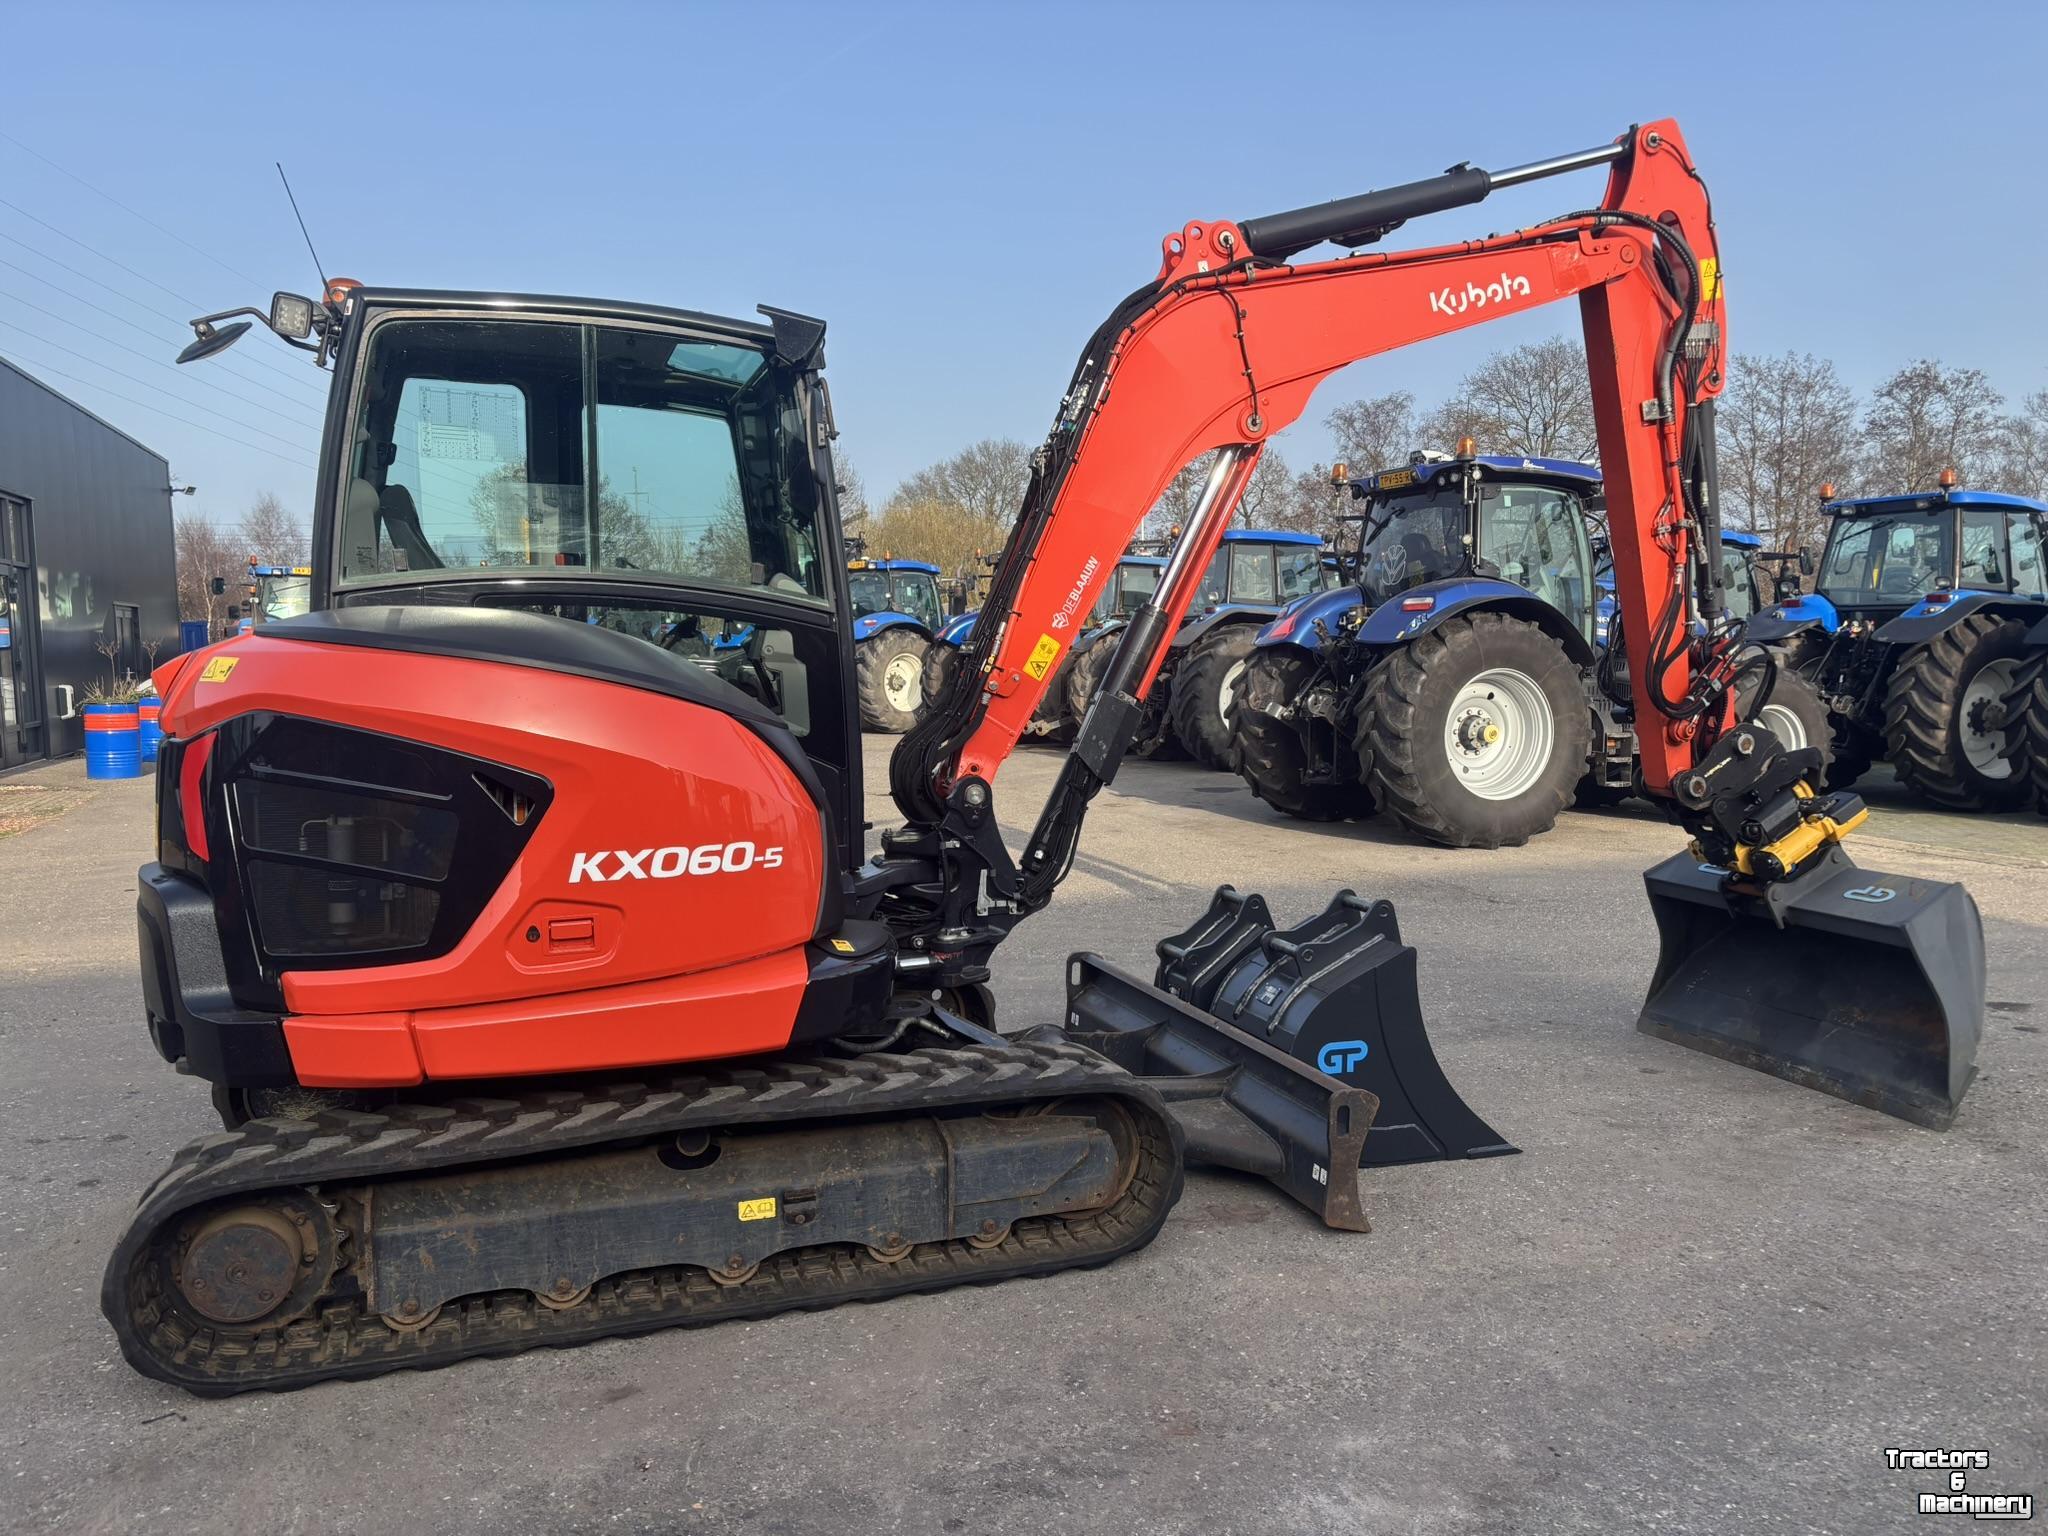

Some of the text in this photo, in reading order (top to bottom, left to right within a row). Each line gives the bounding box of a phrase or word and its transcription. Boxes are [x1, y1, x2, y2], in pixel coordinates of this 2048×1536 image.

[1429, 272, 1531, 315] Kubota
[568, 841, 784, 884] KX060-5
[1317, 1039, 1369, 1074] GP
